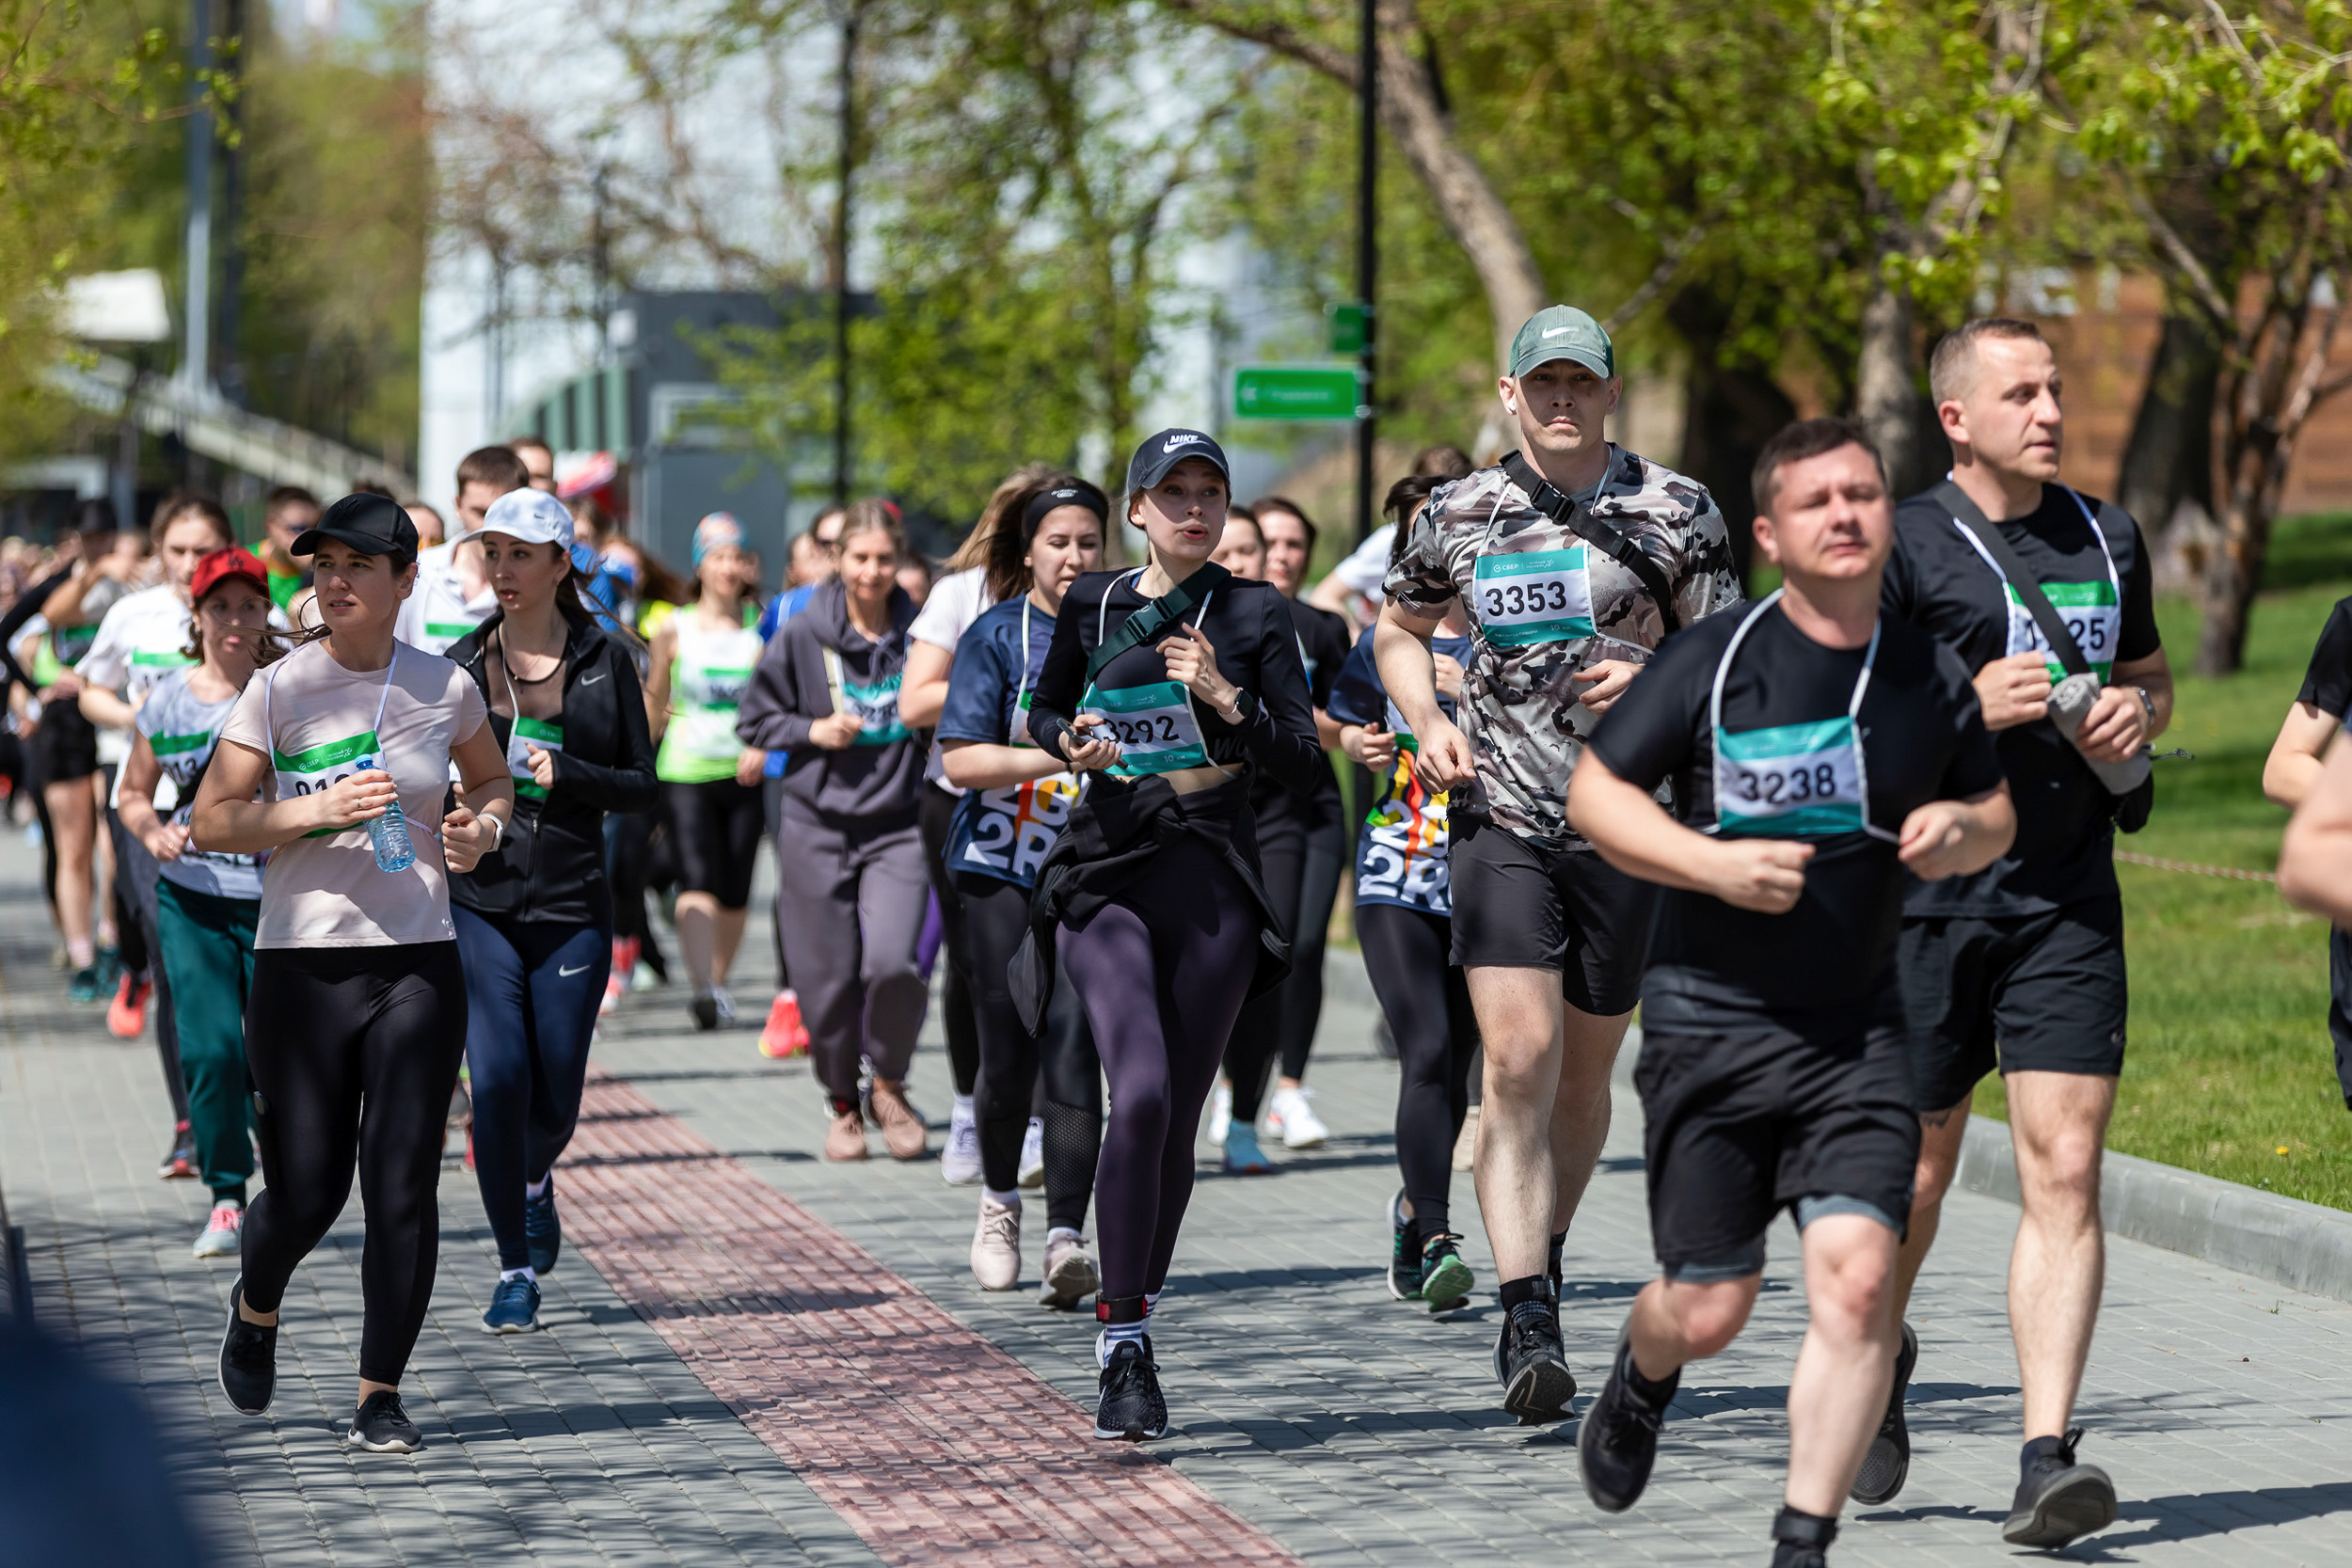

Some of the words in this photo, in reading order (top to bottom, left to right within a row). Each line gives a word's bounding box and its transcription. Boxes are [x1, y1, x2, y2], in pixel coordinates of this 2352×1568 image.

[1169, 434, 1199, 444] NIKE
[1486, 580, 1566, 616] 3353
[2025, 617, 2106, 651] 125
[1103, 715, 1180, 744] 3292
[1740, 764, 1836, 804] 3238
